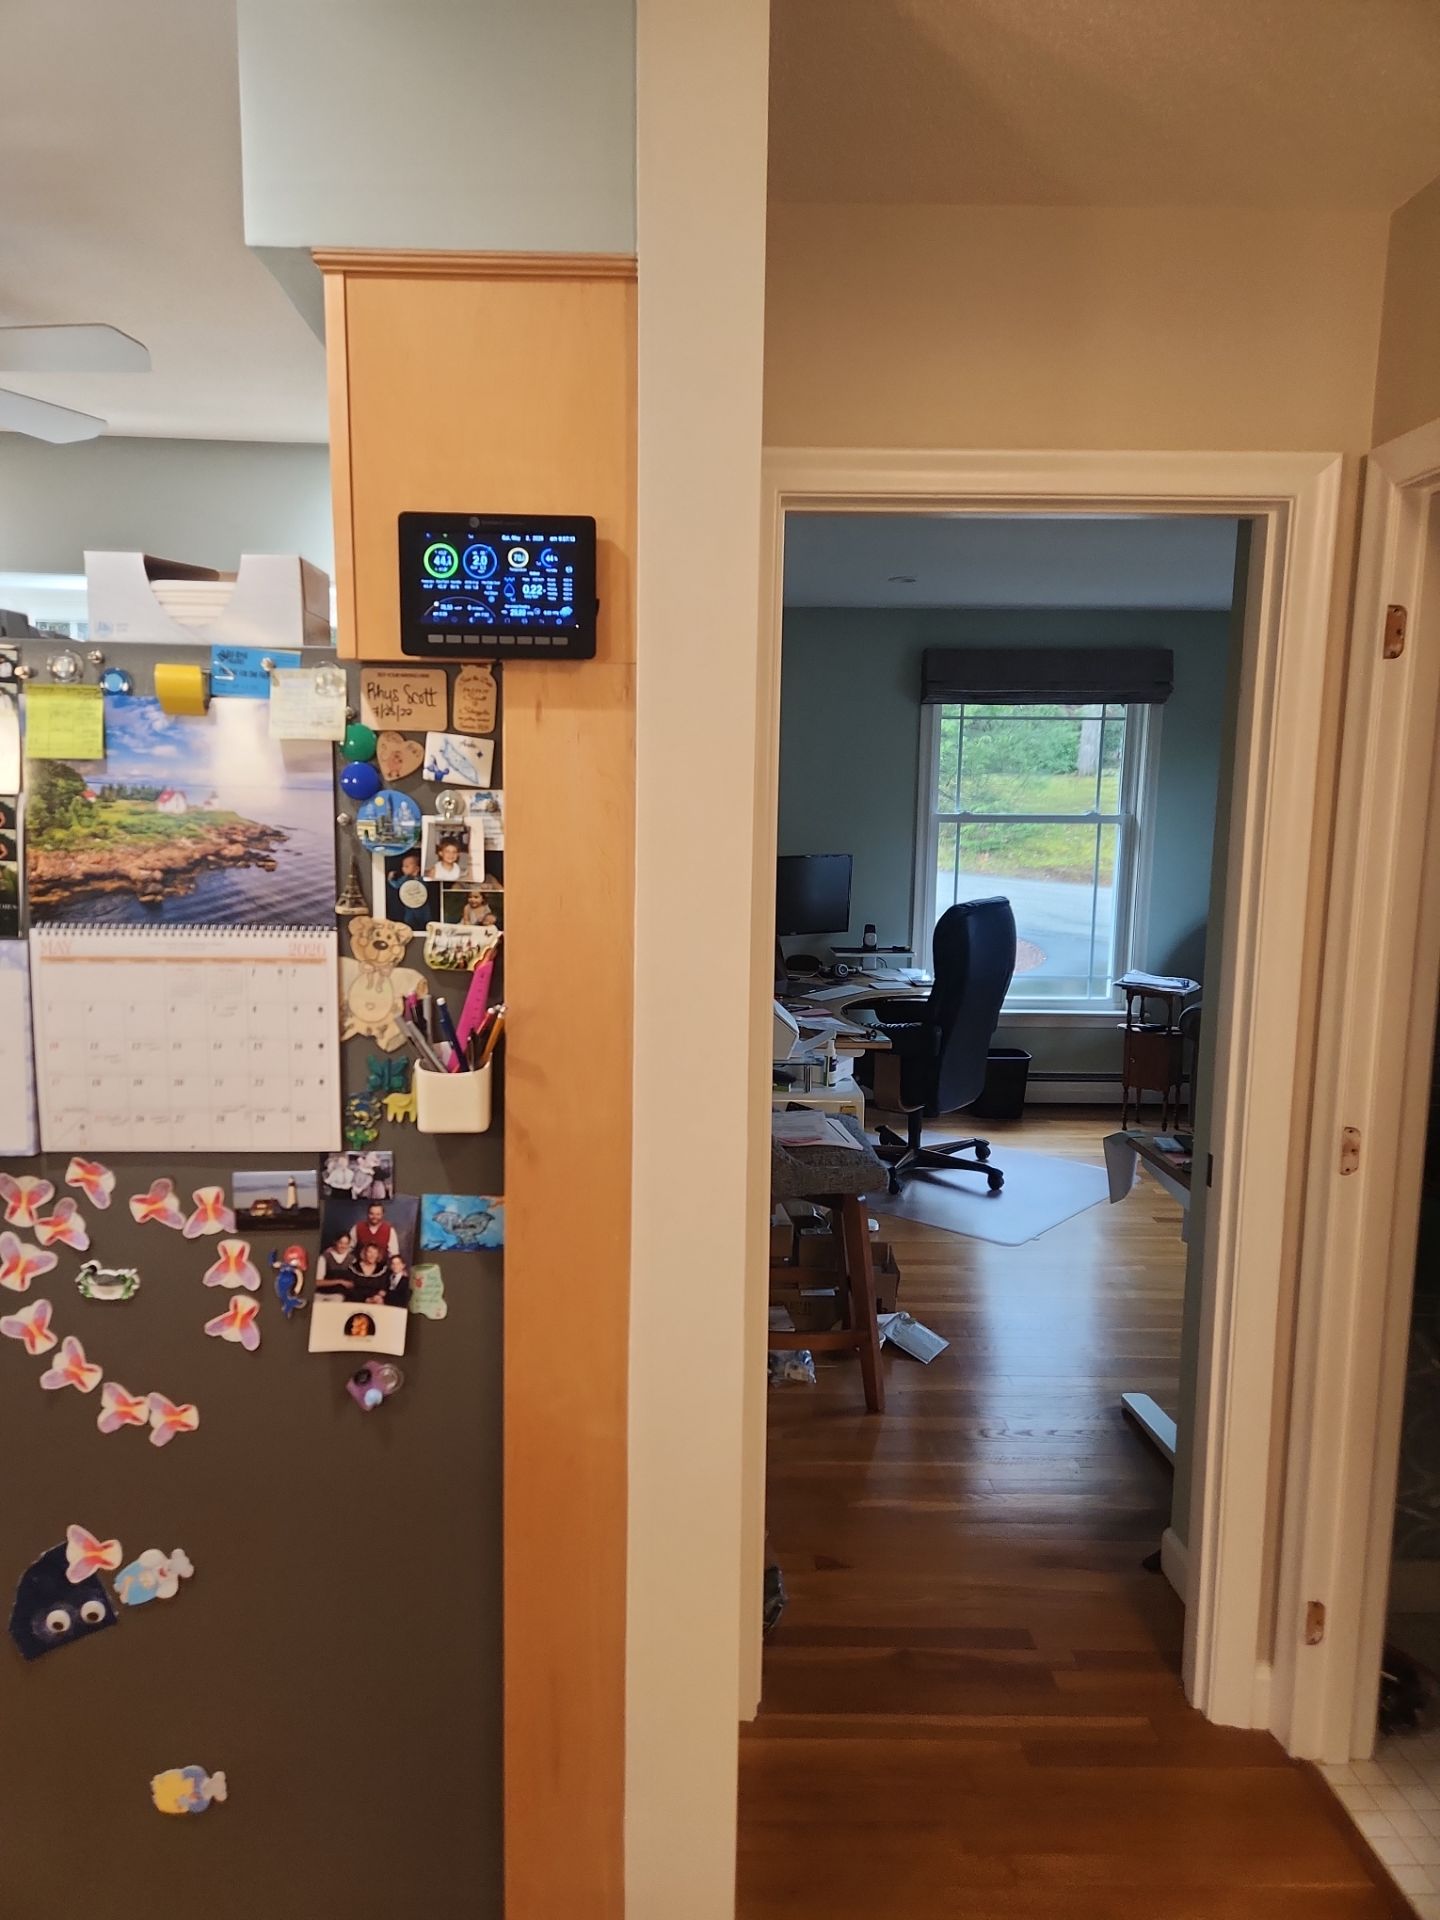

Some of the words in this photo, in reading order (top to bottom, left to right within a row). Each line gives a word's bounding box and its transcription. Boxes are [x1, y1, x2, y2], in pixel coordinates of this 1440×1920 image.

[522, 584, 543, 596] 0.22
[367, 682, 400, 708] Rhys
[403, 684, 438, 707] Scott
[41, 941, 72, 955] MAY
[288, 943, 326, 957] 2026
